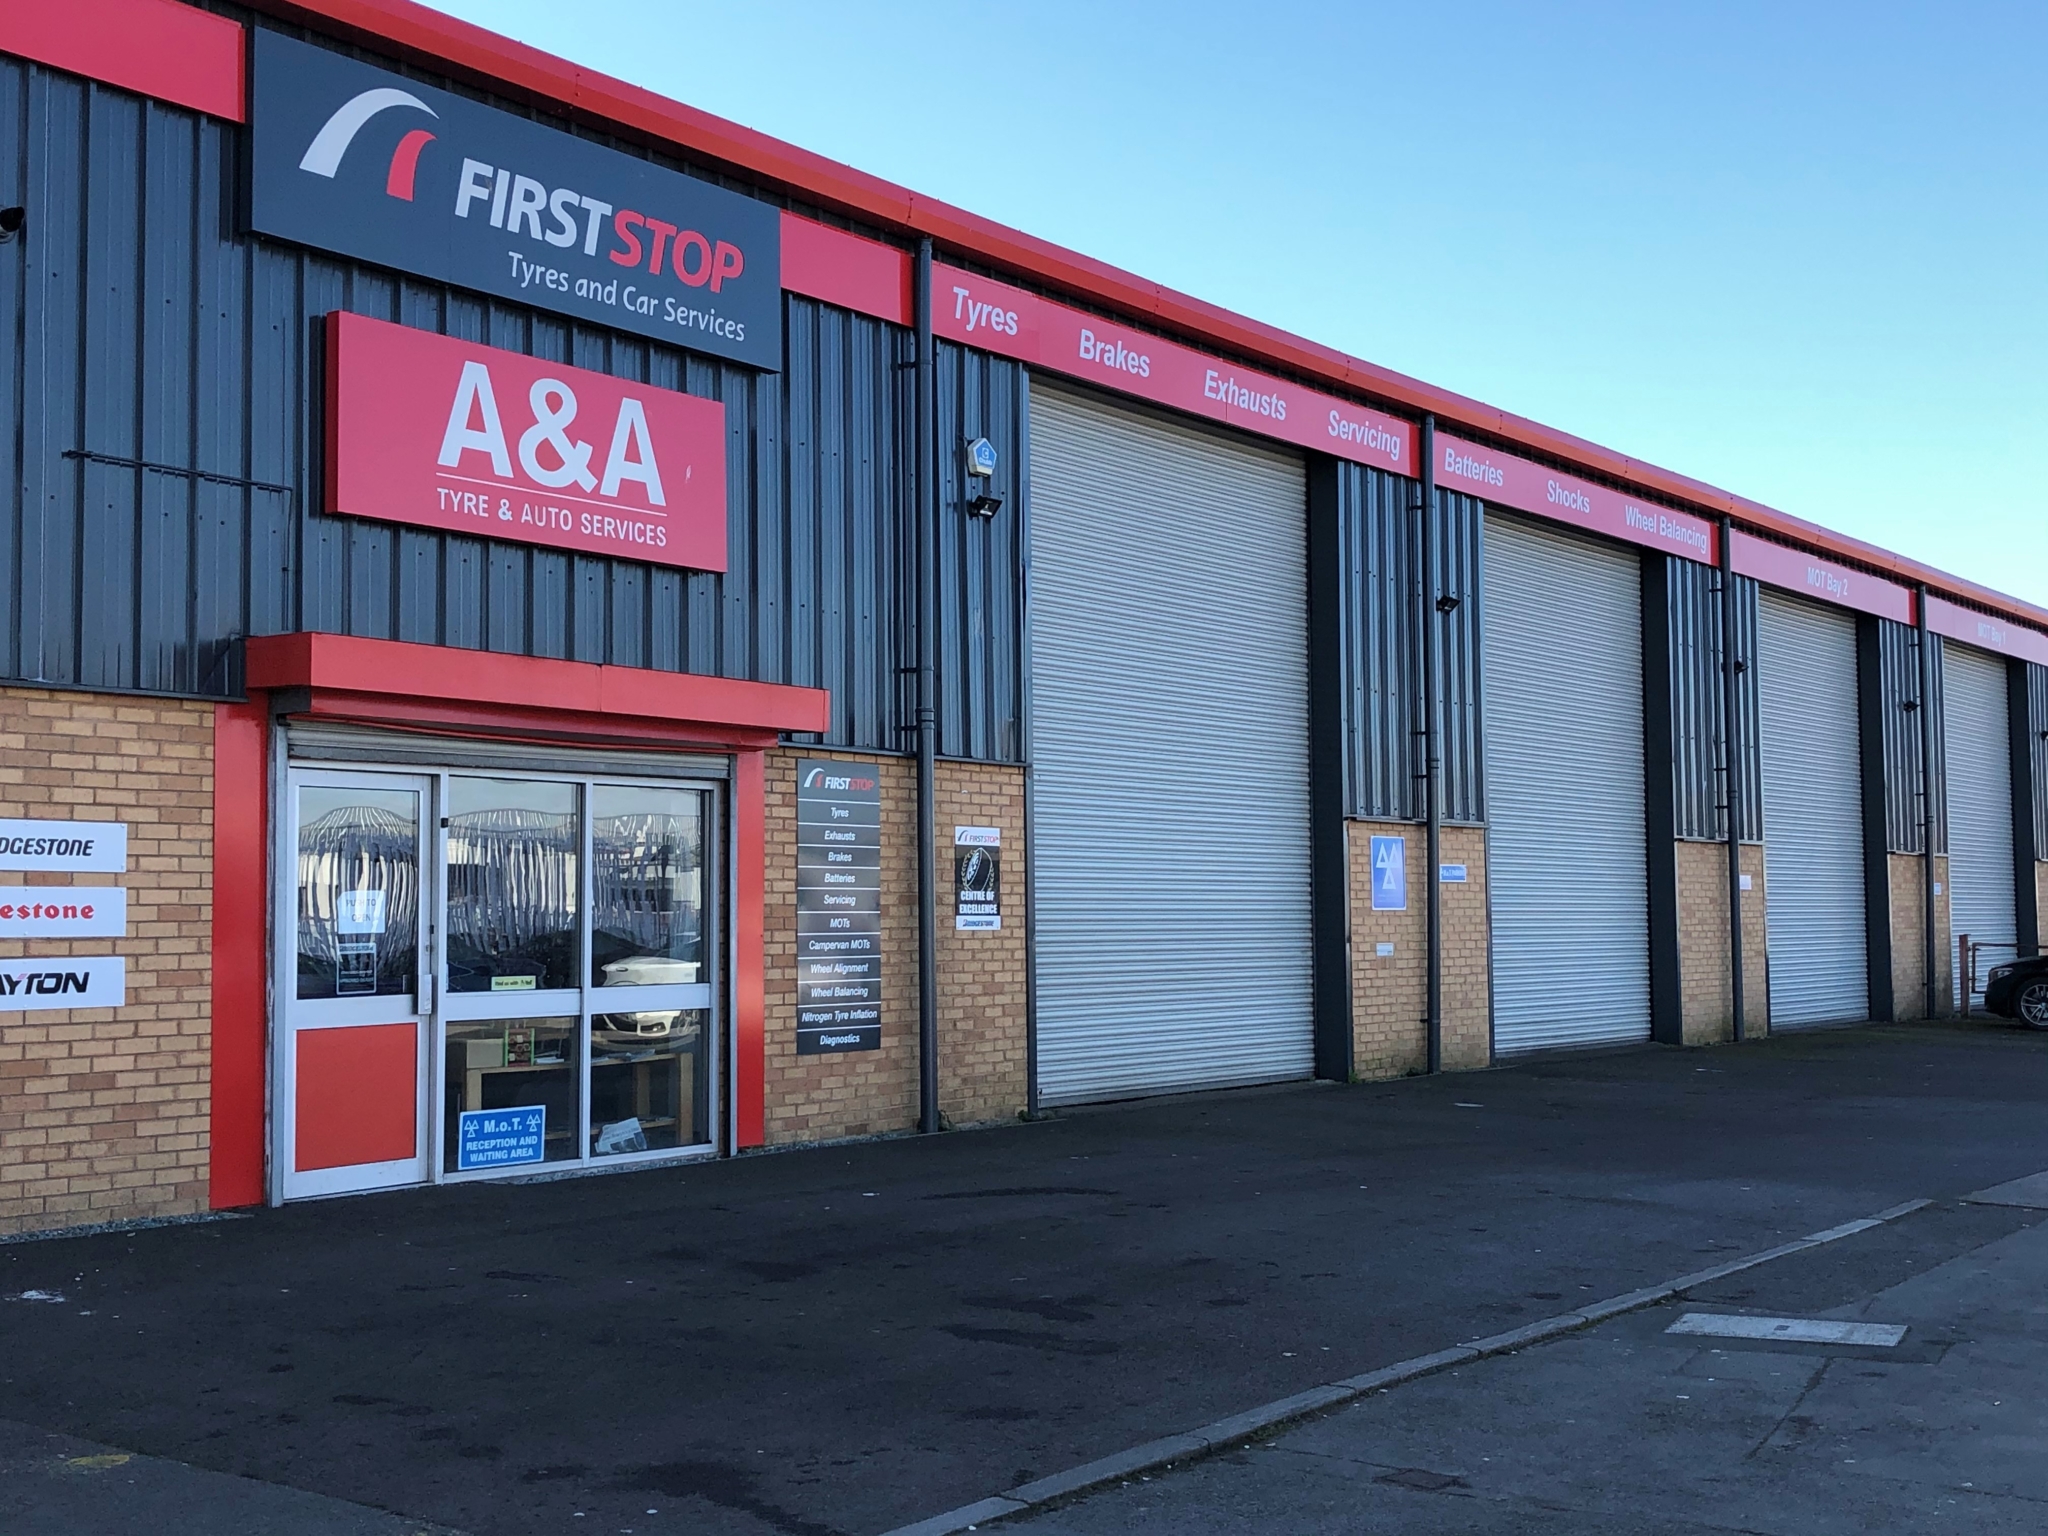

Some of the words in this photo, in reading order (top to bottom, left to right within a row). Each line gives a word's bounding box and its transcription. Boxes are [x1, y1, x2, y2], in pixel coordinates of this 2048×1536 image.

[508, 250, 569, 292] Tyres
[574, 279, 618, 306] and
[622, 285, 659, 318] Car
[663, 297, 745, 341] Services
[952, 286, 1018, 336] Tyres
[1079, 328, 1150, 378] Brakes
[1204, 369, 1287, 421] Exhausts
[437, 360, 667, 507] A&A
[1327, 409, 1400, 461] Servicing
[1444, 447, 1504, 487] Batteries
[1546, 479, 1590, 514] Shocks
[436, 487, 489, 518] TYRE
[497, 498, 513, 521] &
[520, 503, 572, 531] AUTO
[580, 512, 667, 547] SERVICES
[1625, 504, 1657, 534] Wheel
[1659, 515, 1707, 554] Balancing
[1807, 566, 1827, 589] MOT
[1827, 573, 1842, 598] Bay
[1843, 578, 1848, 596] 2
[831, 807, 849, 819] Tyres
[824, 830, 856, 841] Exhausts
[828, 852, 853, 862] Brakes
[824, 873, 856, 883] Batteries
[366, 898, 377, 907] TO
[823, 894, 857, 906] Servicing
[960, 890, 986, 901] CENTRE
[986, 890, 995, 901] OF
[959, 903, 998, 914] EXCELLENCE
[830, 918, 850, 928] MOTs
[809, 940, 849, 951] Campervan
[850, 939, 871, 950] MOTs
[810, 964, 833, 974] Wheel
[833, 963, 869, 975] Alignment
[811, 987, 833, 998] Wheel
[834, 986, 869, 998] Balancing
[802, 1011, 832, 1023] Nitrogen
[834, 1010, 849, 1022] Tyre
[850, 1008, 878, 1019] Inflation
[819, 1034, 860, 1047] Diagnostics
[483, 1117, 523, 1134] M.o.T.
[466, 1137, 517, 1151] RECEPTION
[519, 1135, 538, 1146] AND
[470, 1149, 508, 1163] WAITING
[510, 1147, 534, 1159] AREA
